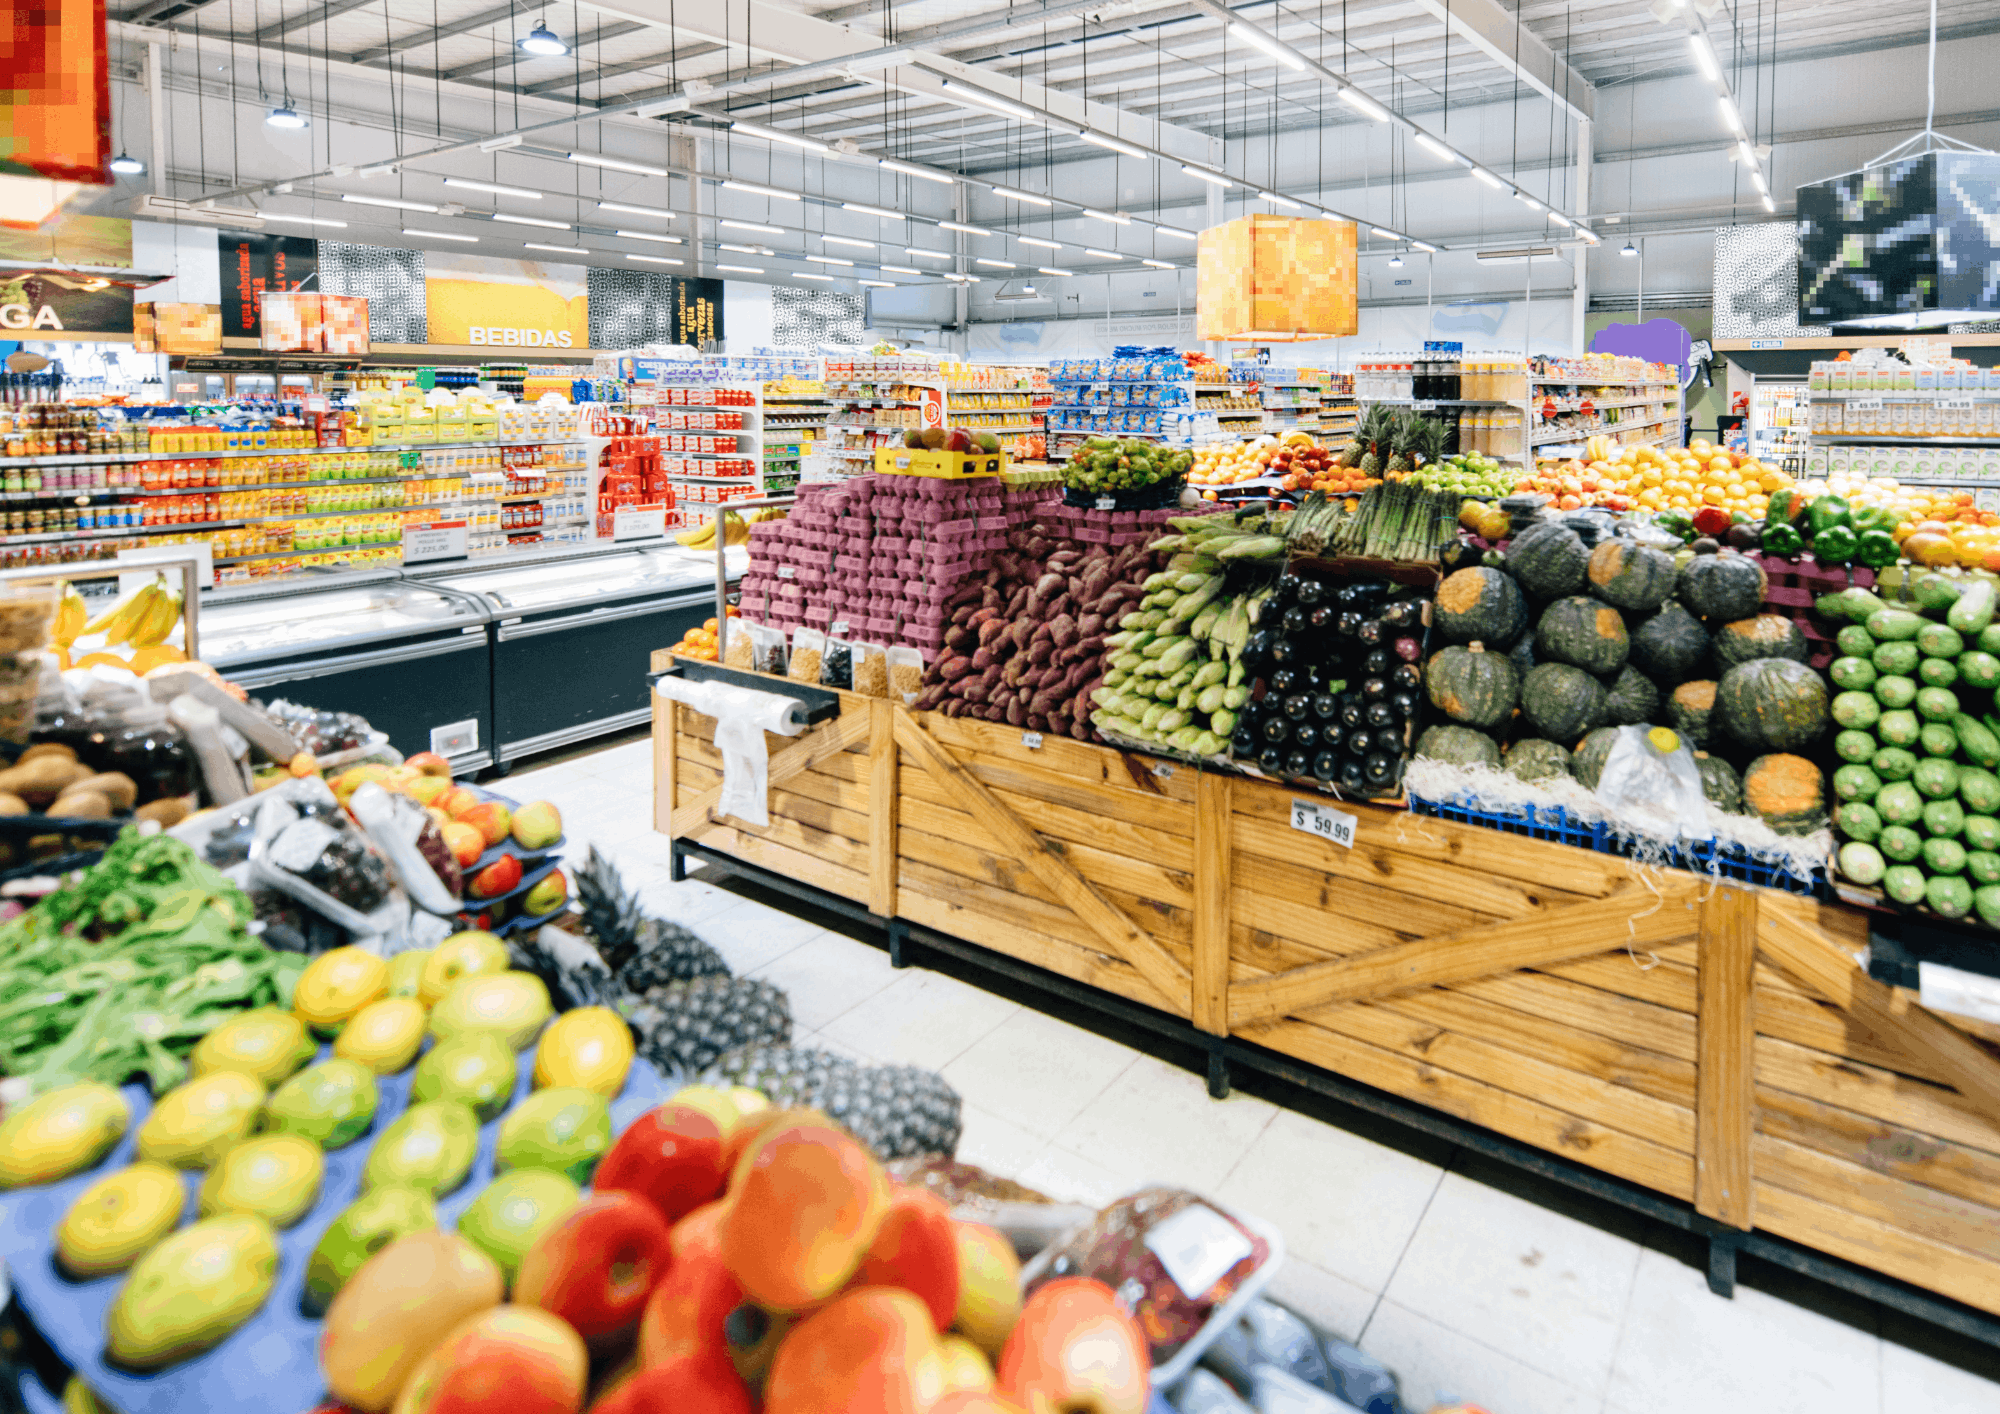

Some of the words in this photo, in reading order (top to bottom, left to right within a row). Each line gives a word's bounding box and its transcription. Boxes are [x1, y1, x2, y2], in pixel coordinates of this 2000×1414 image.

[236, 243, 250, 301] saborizada
[241, 303, 255, 329] agua
[677, 281, 687, 324] saborizada
[687, 306, 697, 333] agua
[469, 326, 573, 348] BEBIDAS
[680, 325, 688, 344] agua
[1297, 811, 1304, 826] $
[1315, 816, 1349, 841] 59.99
